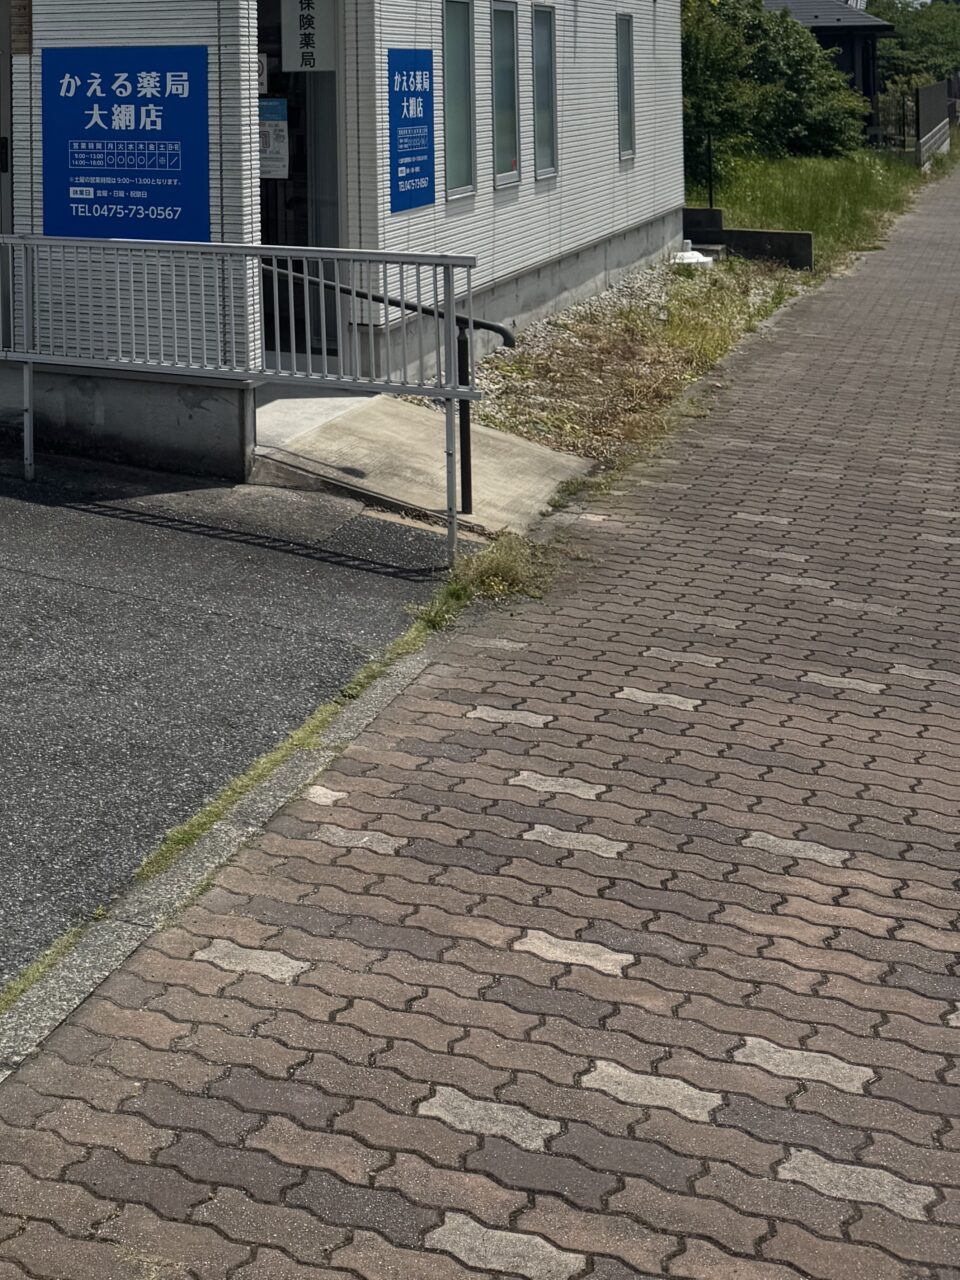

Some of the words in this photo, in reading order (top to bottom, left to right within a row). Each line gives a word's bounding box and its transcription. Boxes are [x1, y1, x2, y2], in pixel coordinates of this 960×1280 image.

[58, 71, 190, 99] かえる薬局
[393, 70, 430, 93] かえる薬局
[83, 103, 164, 131] 大網店
[401, 96, 424, 119] 大網店
